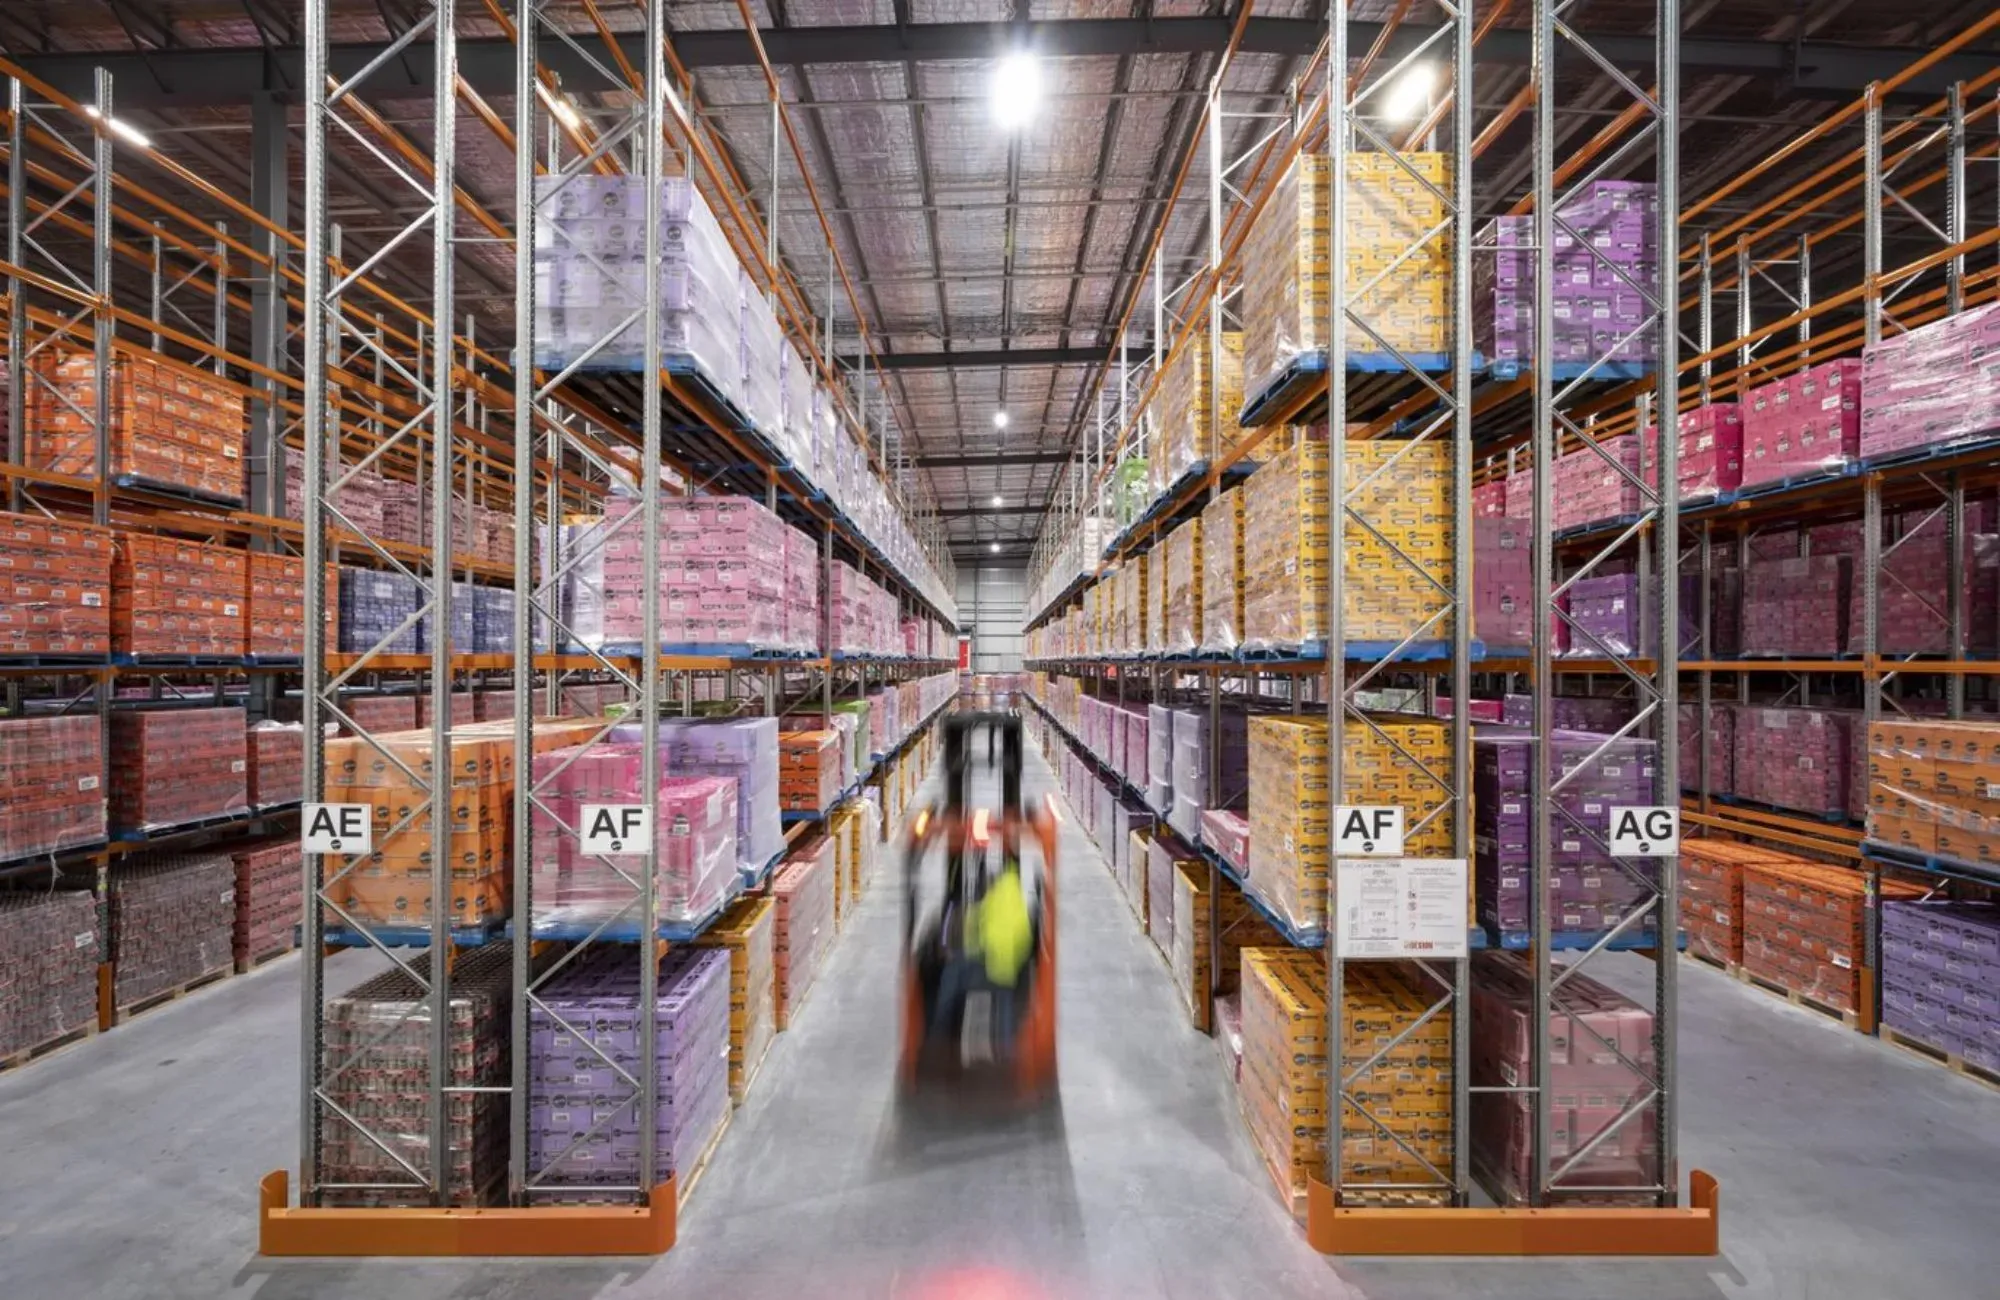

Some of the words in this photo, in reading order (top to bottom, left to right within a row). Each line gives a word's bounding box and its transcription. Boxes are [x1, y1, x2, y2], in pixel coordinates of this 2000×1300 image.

[309, 807, 362, 837] AE
[589, 808, 643, 838] AF
[1341, 810, 1394, 840] AF
[1615, 810, 1673, 841] AG
